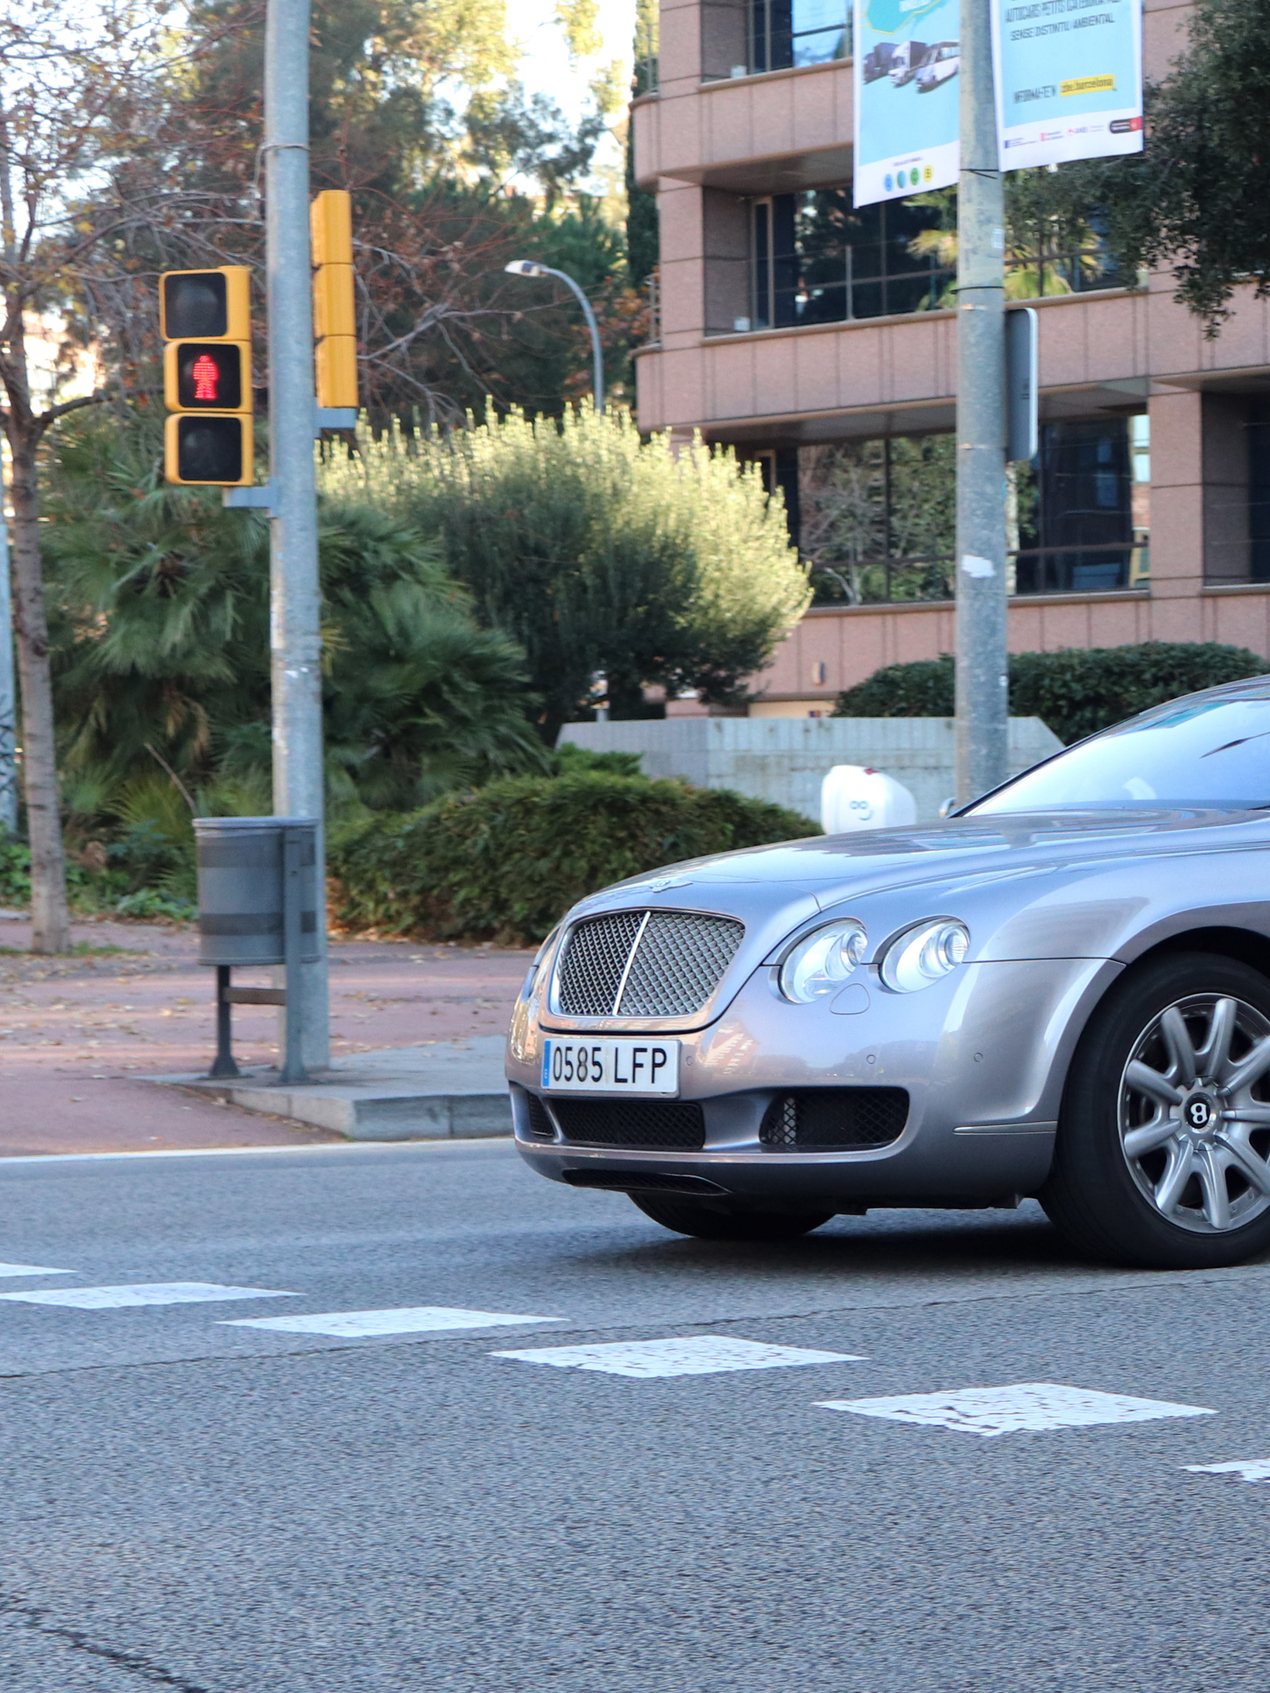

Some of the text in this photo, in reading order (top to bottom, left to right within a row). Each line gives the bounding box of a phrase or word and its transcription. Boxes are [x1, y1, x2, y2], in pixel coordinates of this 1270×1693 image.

[1010, 28, 1034, 41] SENSE
[1073, 13, 1115, 29] AMBIENTAL
[553, 1046, 668, 1084] 0585 LFP
